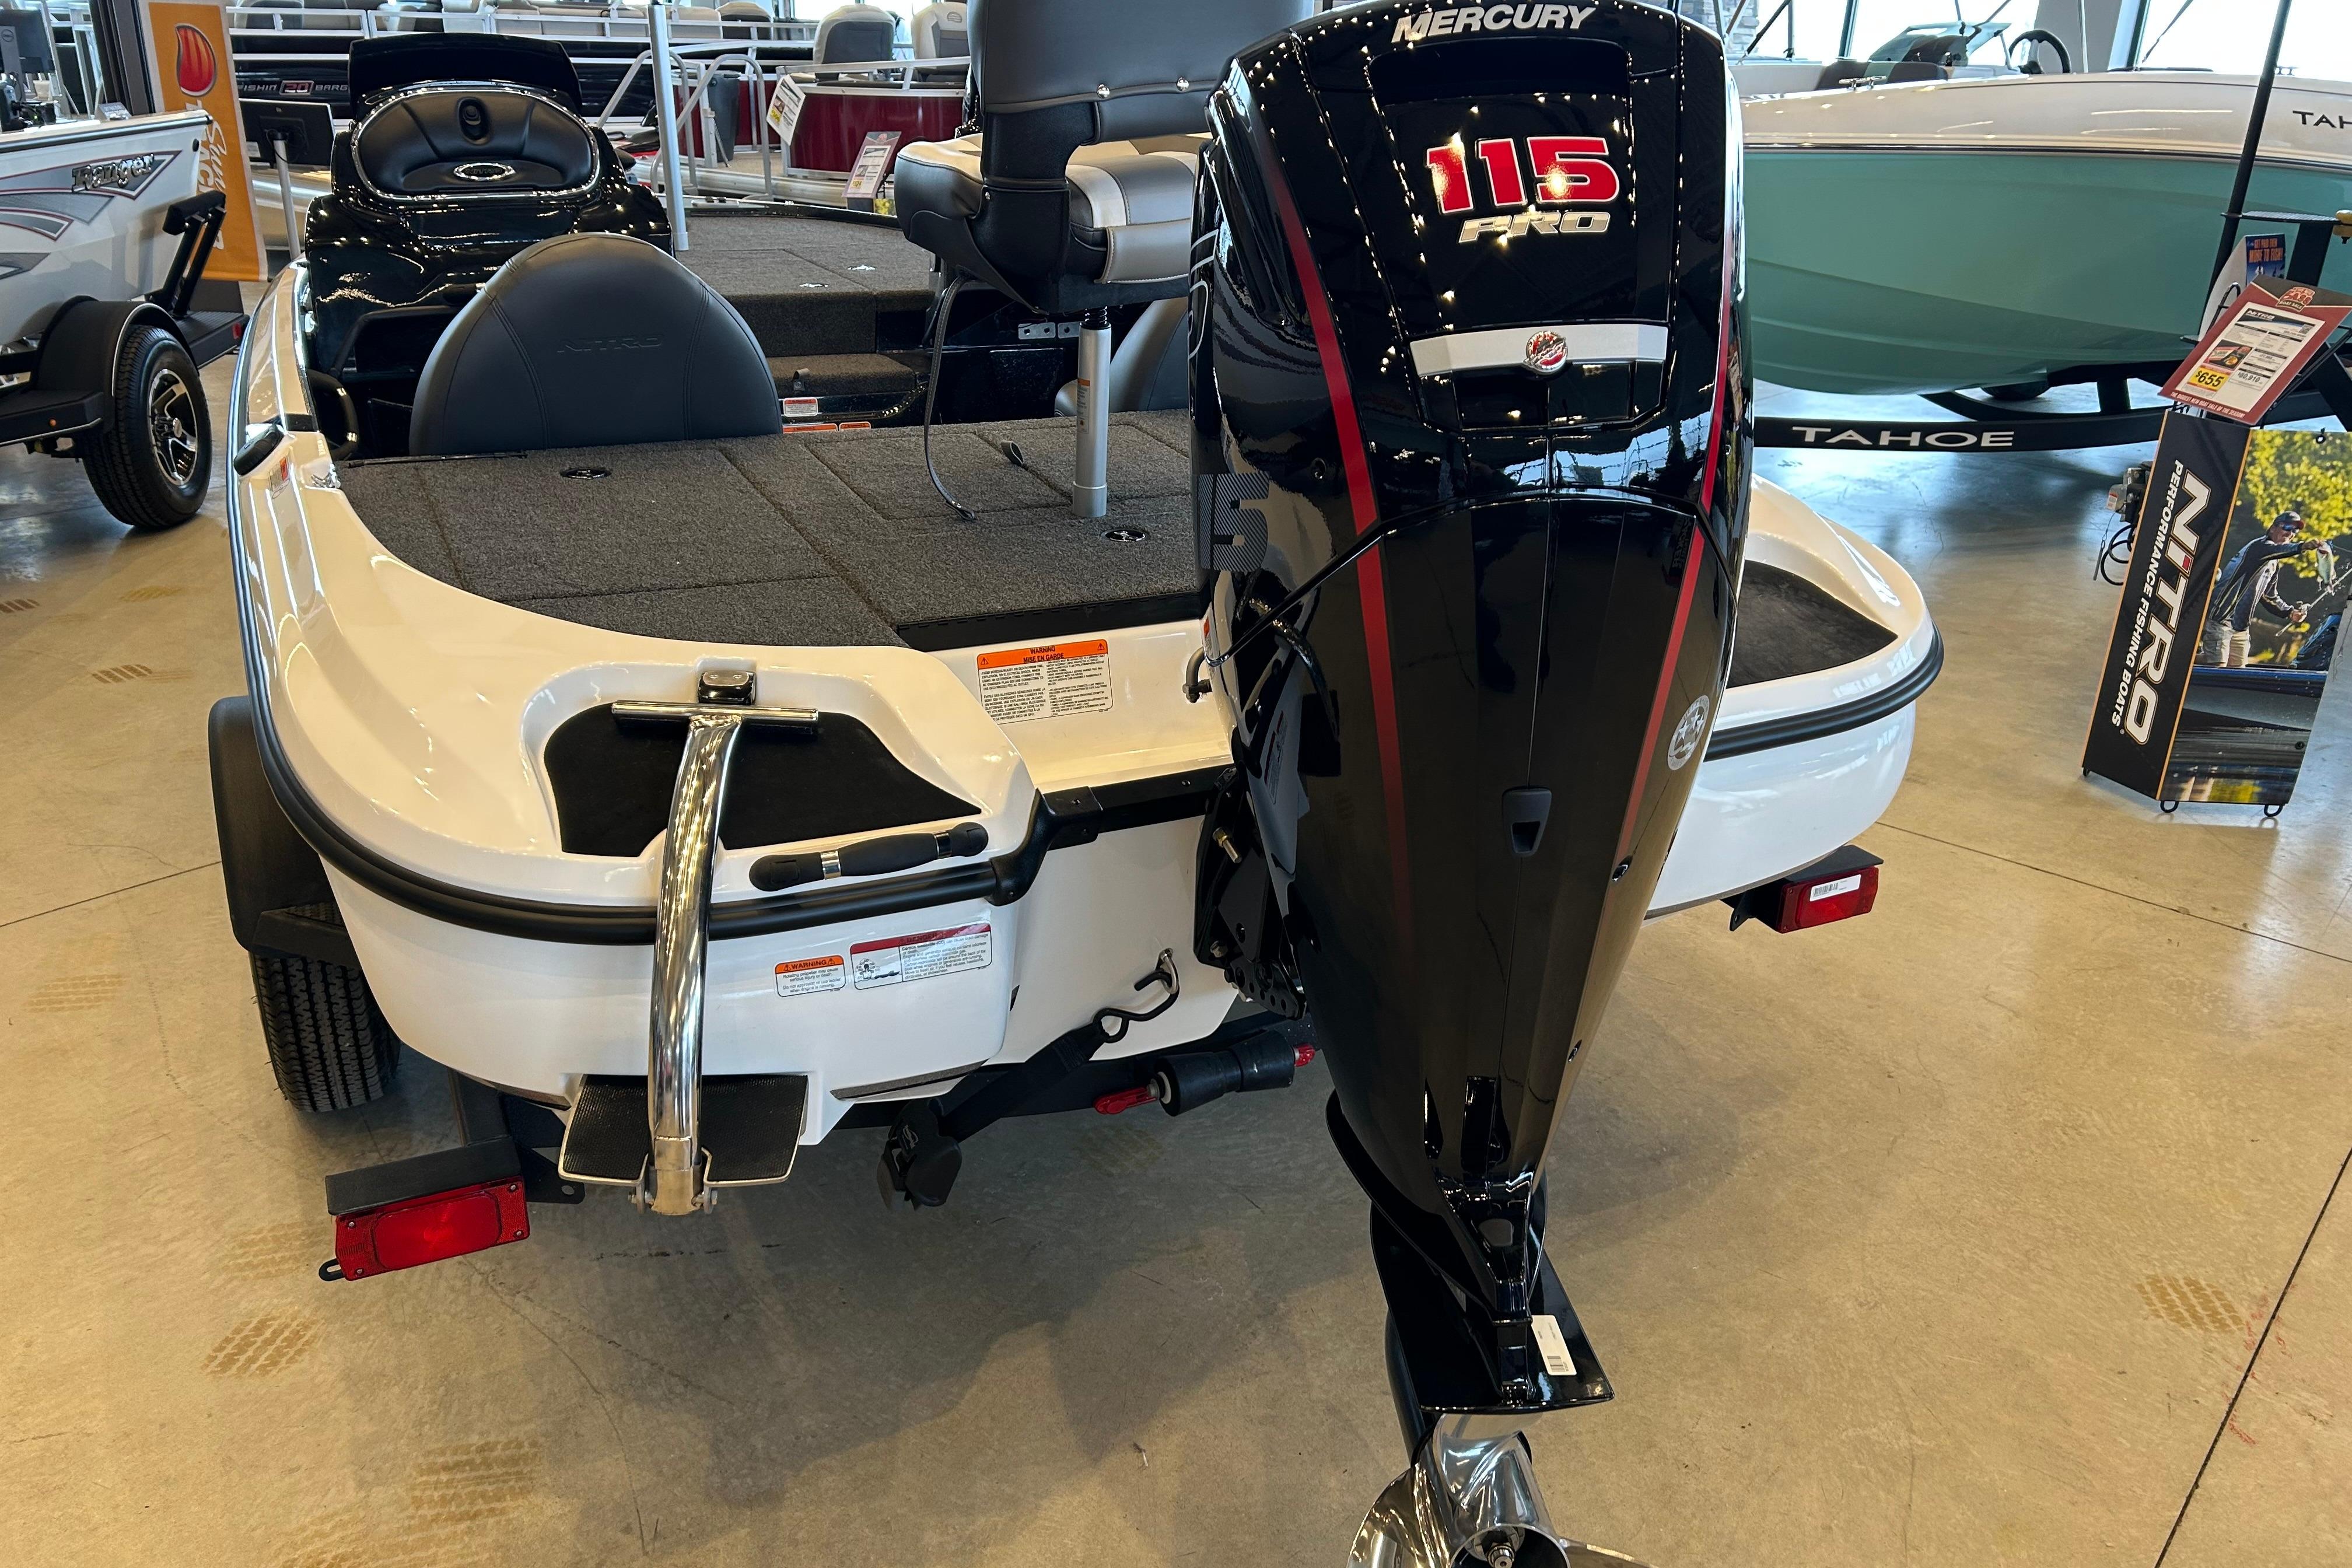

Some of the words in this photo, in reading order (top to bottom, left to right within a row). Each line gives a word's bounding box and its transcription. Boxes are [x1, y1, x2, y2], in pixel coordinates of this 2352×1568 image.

[1391, 4, 1597, 43] MERCURY
[284, 83, 309, 93] 20
[72, 153, 155, 193] Ranger
[1427, 135, 1620, 214] 115
[1458, 211, 1611, 243] PRO
[2195, 369, 2224, 387] $655
[1791, 426, 2014, 447] TAHOE
[2143, 460, 2183, 597] PERFORMANCE
[2124, 469, 2211, 746] NITRO
[1030, 646, 1055, 654] WARNING
[2124, 600, 2150, 668] FISHING
[1045, 653, 1065, 661] GARDE
[2112, 670, 2133, 727] BOATS
[792, 960, 827, 969] WARNING
